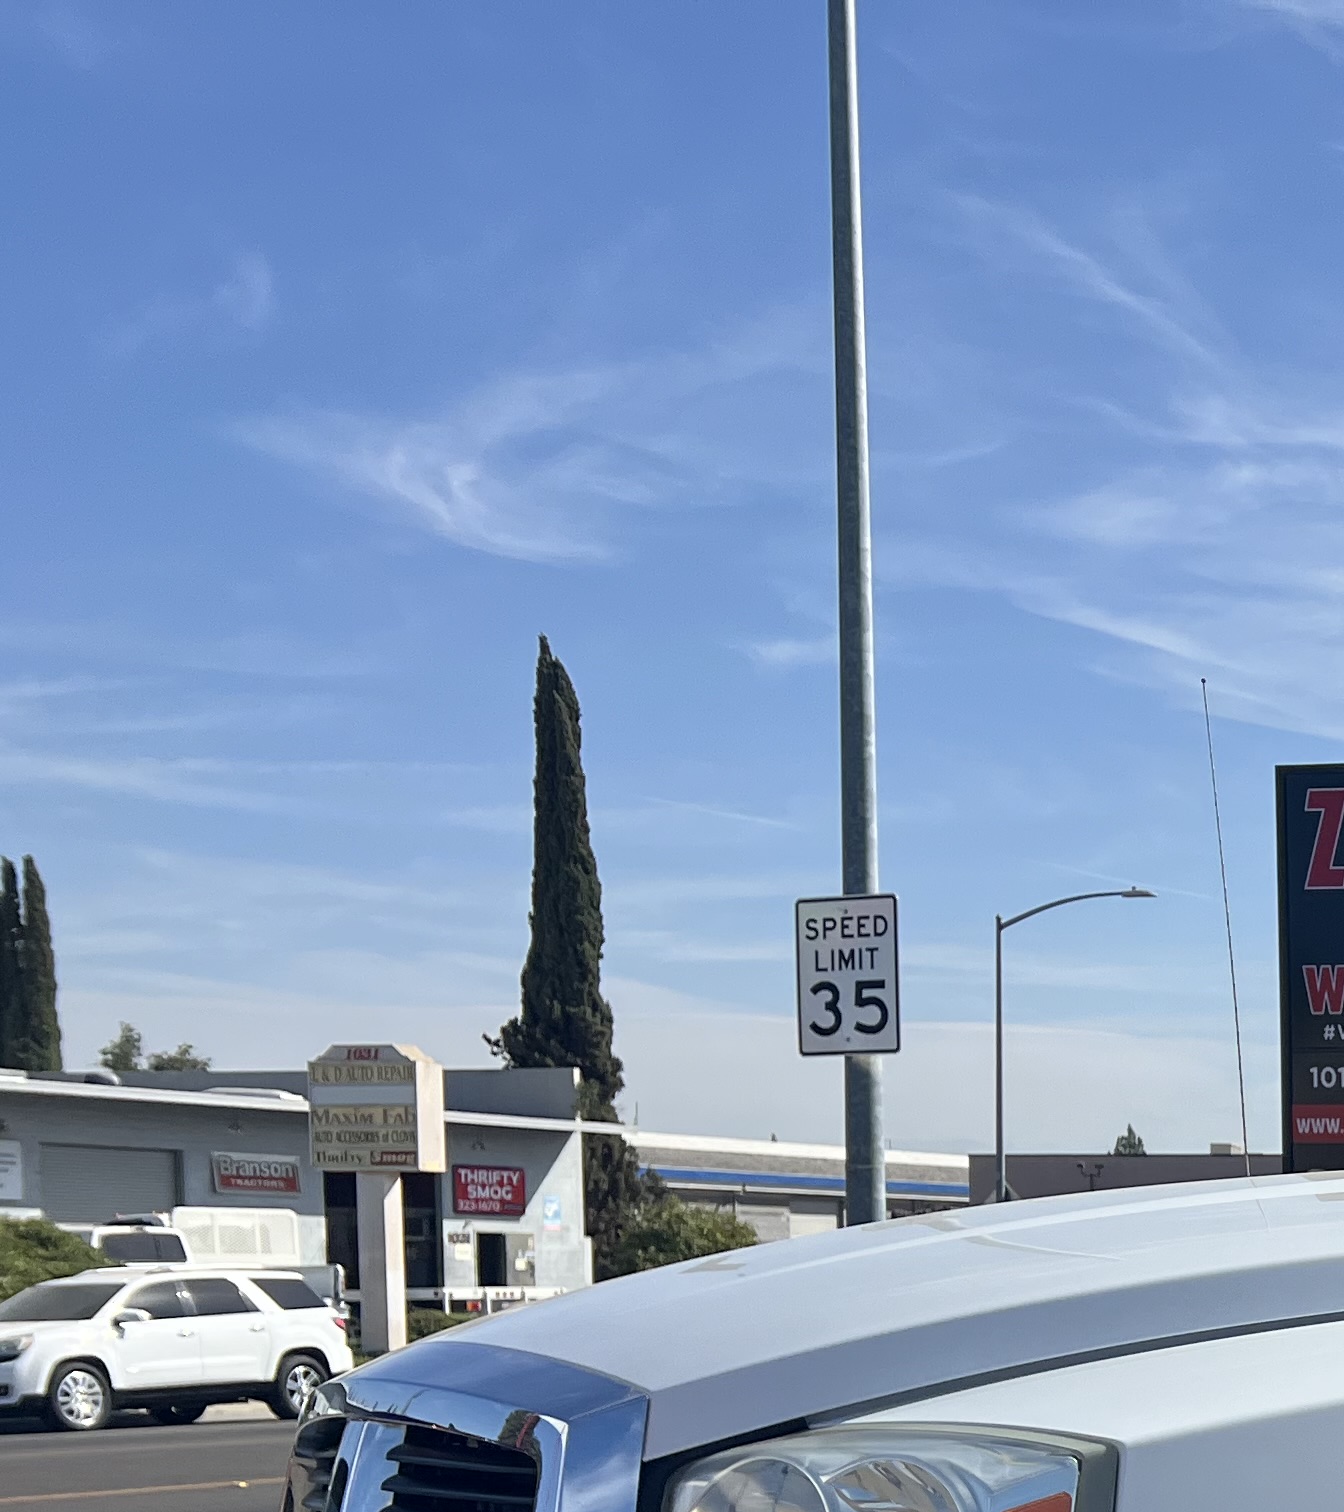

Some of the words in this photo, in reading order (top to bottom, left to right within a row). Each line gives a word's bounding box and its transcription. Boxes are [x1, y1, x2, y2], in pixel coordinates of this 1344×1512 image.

[805, 914, 888, 941] SPEED
[814, 947, 879, 972] LIMIT
[809, 979, 889, 1037] 35
[344, 1065, 374, 1081] AUTO
[377, 1064, 414, 1081] REPAIR
[220, 1155, 294, 1178] Branson
[458, 1168, 520, 1185] THRIFTY
[467, 1184, 513, 1200] SMOG
